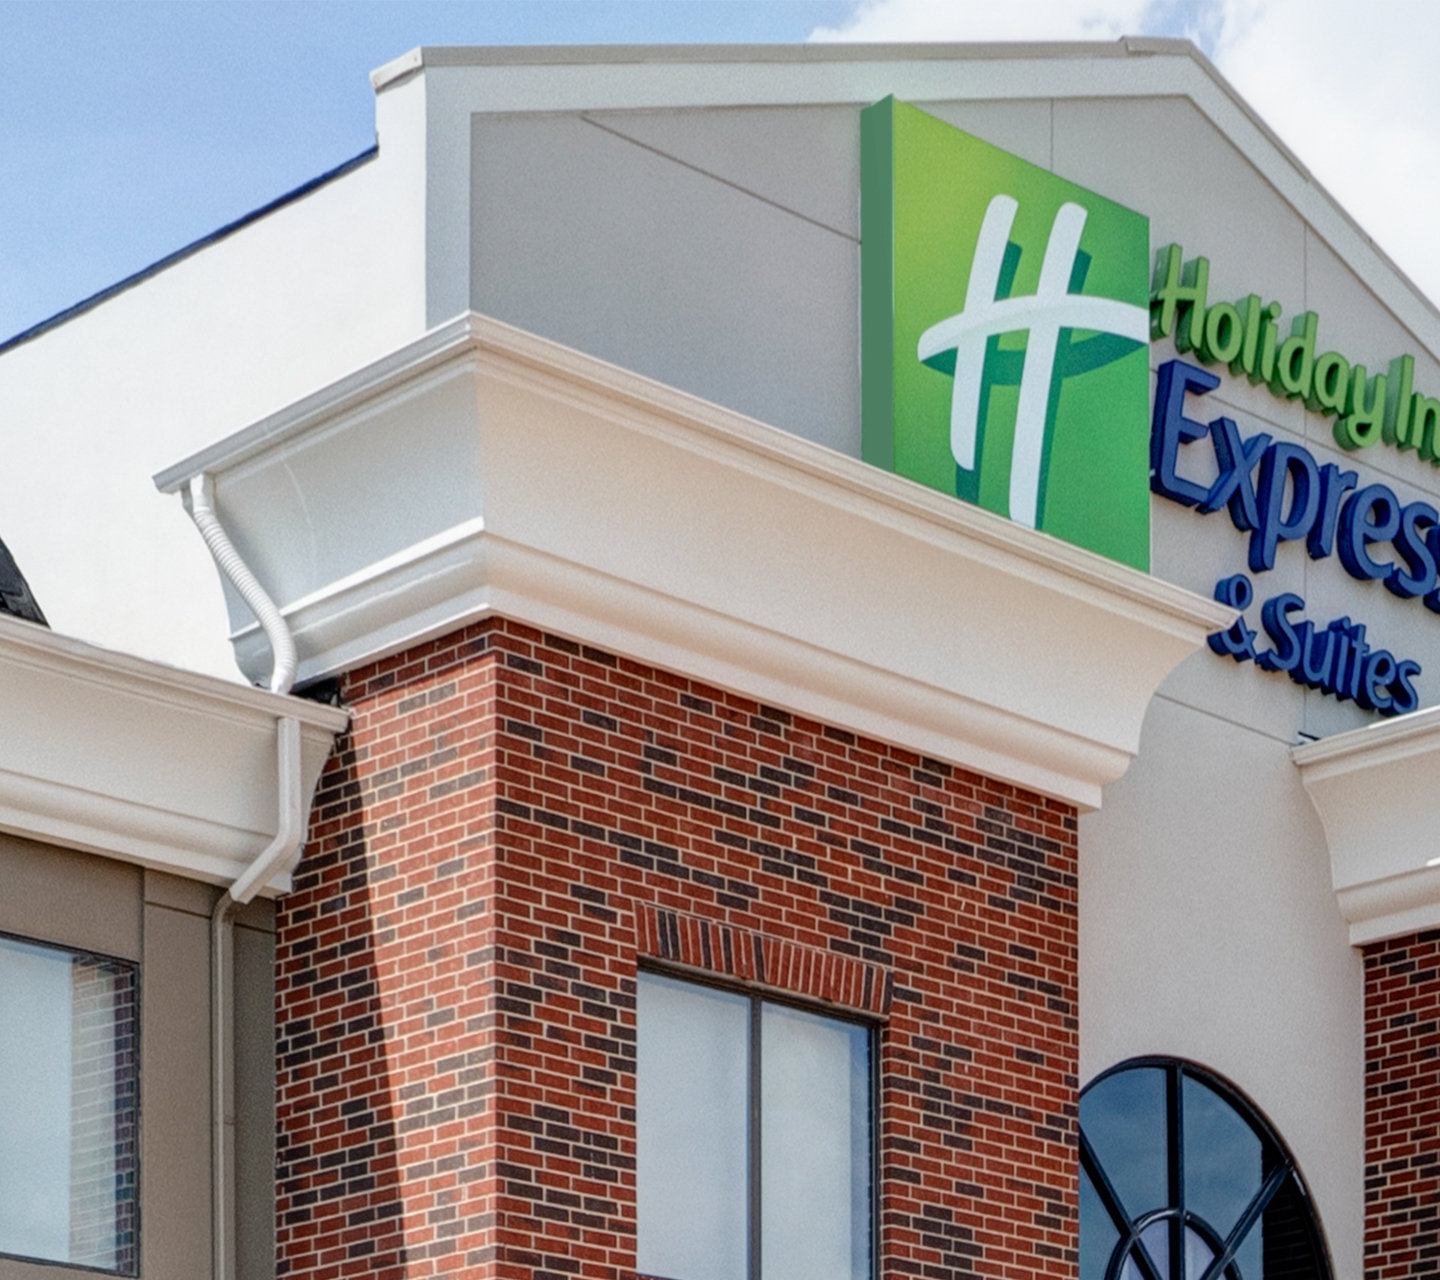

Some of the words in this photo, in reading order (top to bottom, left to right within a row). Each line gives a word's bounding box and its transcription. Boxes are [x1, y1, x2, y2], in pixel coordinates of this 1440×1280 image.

[1150, 242, 1388, 451] Holiday
[1206, 573, 1257, 662] &
[1255, 592, 1422, 717] Suites
